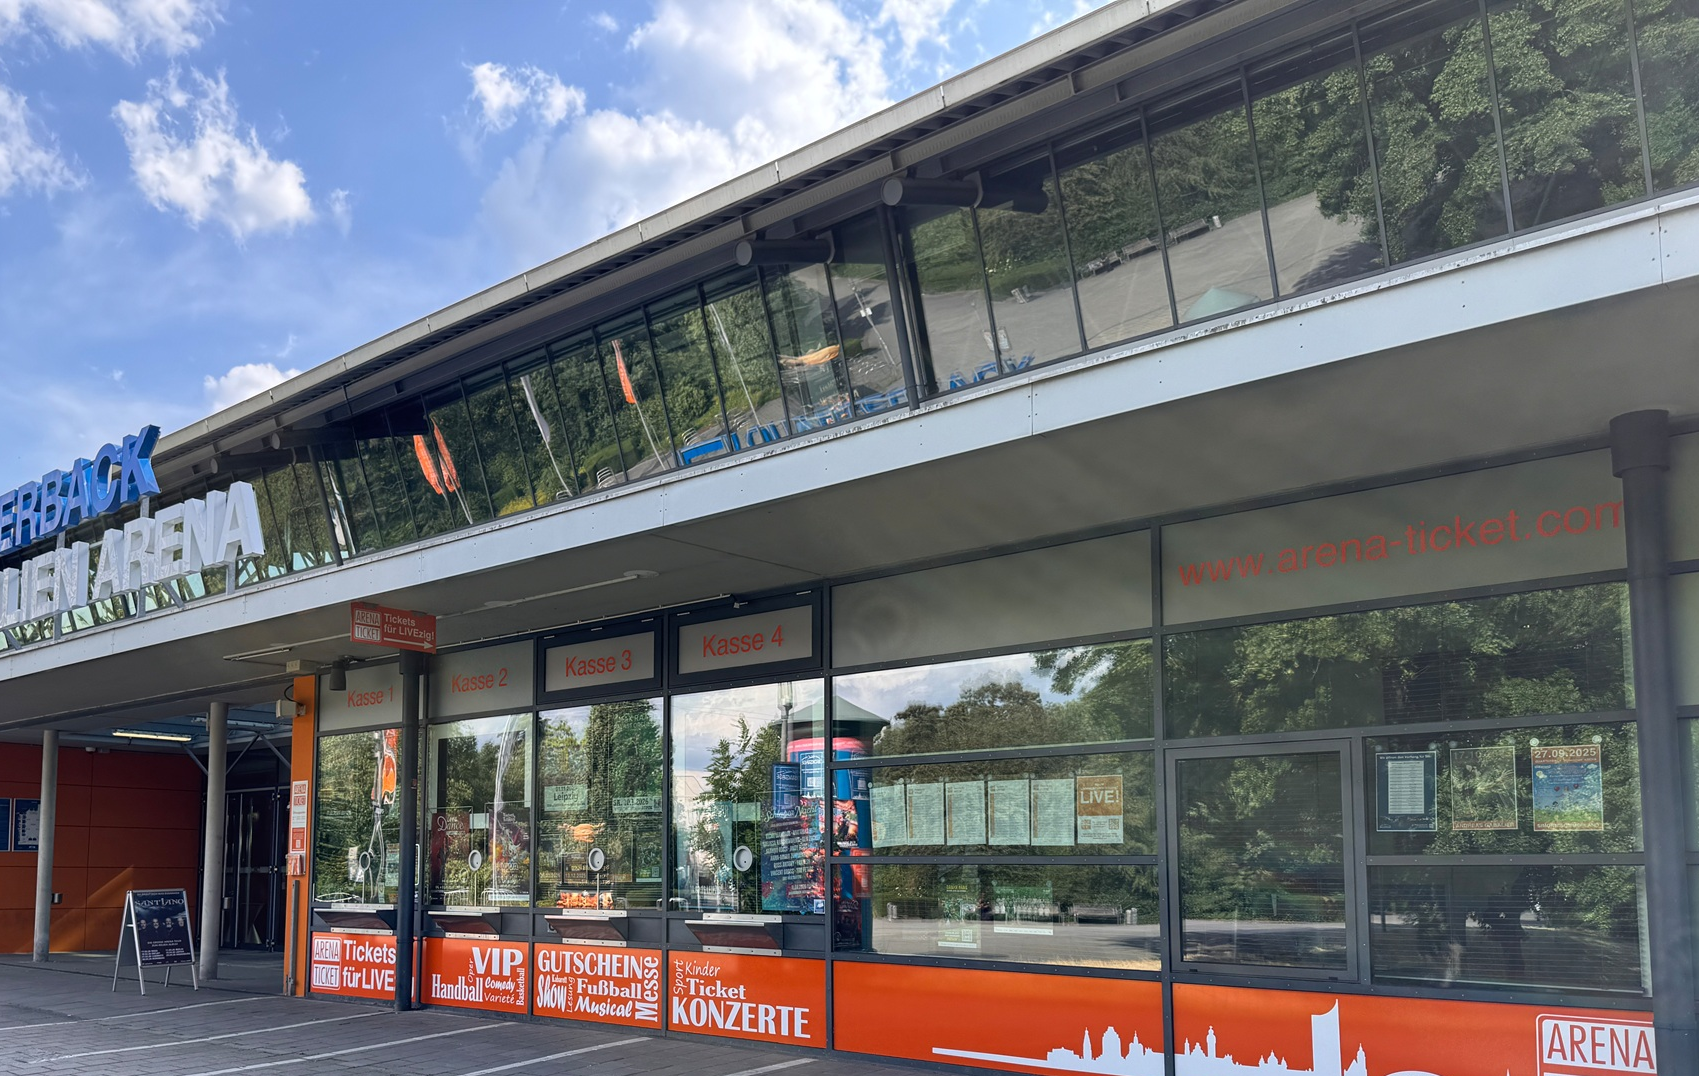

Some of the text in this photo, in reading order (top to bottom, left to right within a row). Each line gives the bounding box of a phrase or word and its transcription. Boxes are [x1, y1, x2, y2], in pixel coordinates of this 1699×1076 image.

[92, 481, 265, 601] ARENA
[1177, 500, 1624, 586] www.arena-ticket.com
[356, 610, 380, 625] ARENA
[384, 613, 416, 627] Tickets
[356, 626, 380, 640] TICKET
[384, 624, 434, 642] für LIVEzig!
[702, 625, 784, 657] Kasse 4
[565, 650, 632, 677] Kasse 3
[451, 668, 508, 693] Kasse 2
[347, 685, 394, 708] Kasse 1
[1535, 748, 1597, 759] 27.09.2025
[553, 791, 579, 802] Leipzig
[1080, 790, 1119, 804] LIVE!
[315, 941, 339, 959] ARENA
[343, 940, 396, 964] Tickets
[472, 946, 524, 976] VIP
[315, 966, 339, 985] TICKET
[537, 949, 643, 979] GUTSCHEIN
[685, 960, 720, 977] Kinder
[342, 966, 361, 988] für
[431, 973, 483, 1002] Handball
[485, 976, 515, 993] Comedy
[516, 968, 525, 1006] Basketball
[576, 978, 642, 999] Fußball
[673, 959, 687, 995] Sport
[686, 977, 746, 1000] Ticket
[484, 992, 515, 1004] Varieté
[566, 976, 576, 1013] Lesung
[635, 956, 659, 1022] Messe
[574, 995, 633, 1018] Musical
[672, 996, 811, 1039] KONZERTE
[1547, 1023, 1655, 1070] ARENA
